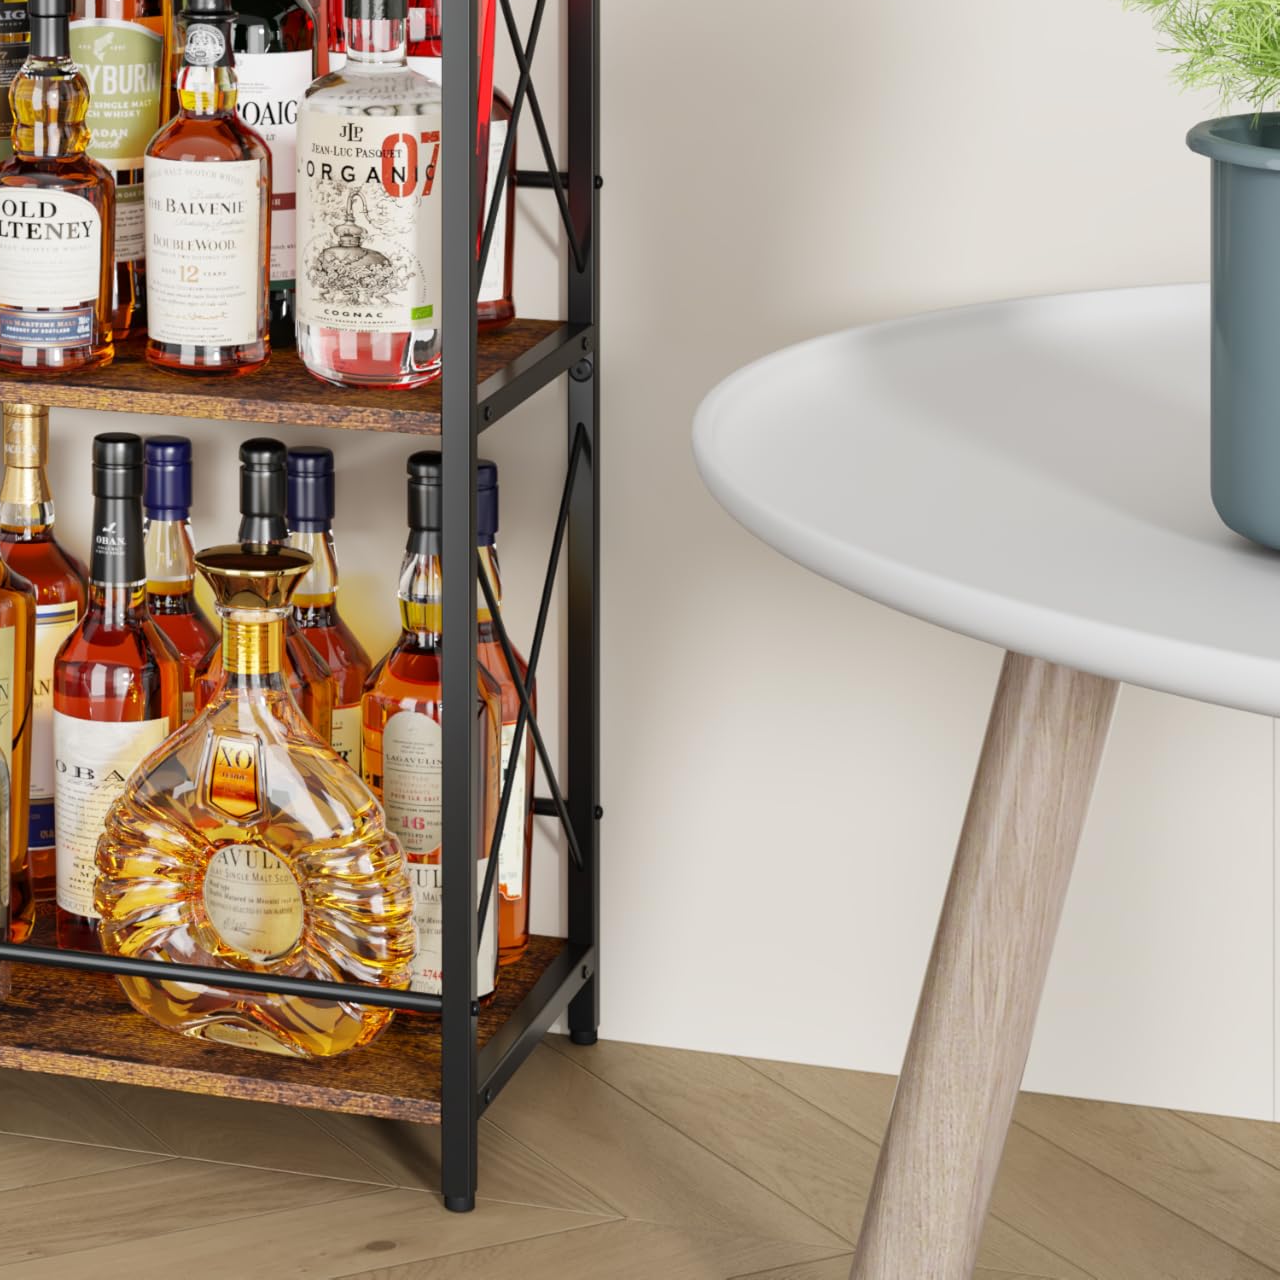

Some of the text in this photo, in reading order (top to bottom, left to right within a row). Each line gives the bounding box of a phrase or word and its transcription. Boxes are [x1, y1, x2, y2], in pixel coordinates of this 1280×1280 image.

[311, 142, 403, 159] JEAN-LUC PASQUET
[1, 199, 58, 219] OLD
[166, 197, 246, 216] BALVENIE
[178, 264, 200, 284] 12
[323, 308, 384, 318] COGNAC
[95, 535, 126, 545] OBAN
[219, 745, 254, 770] XO
[55, 758, 125, 783] OBA
[401, 815, 426, 830] 16
[252, 872, 273, 883] MALT
